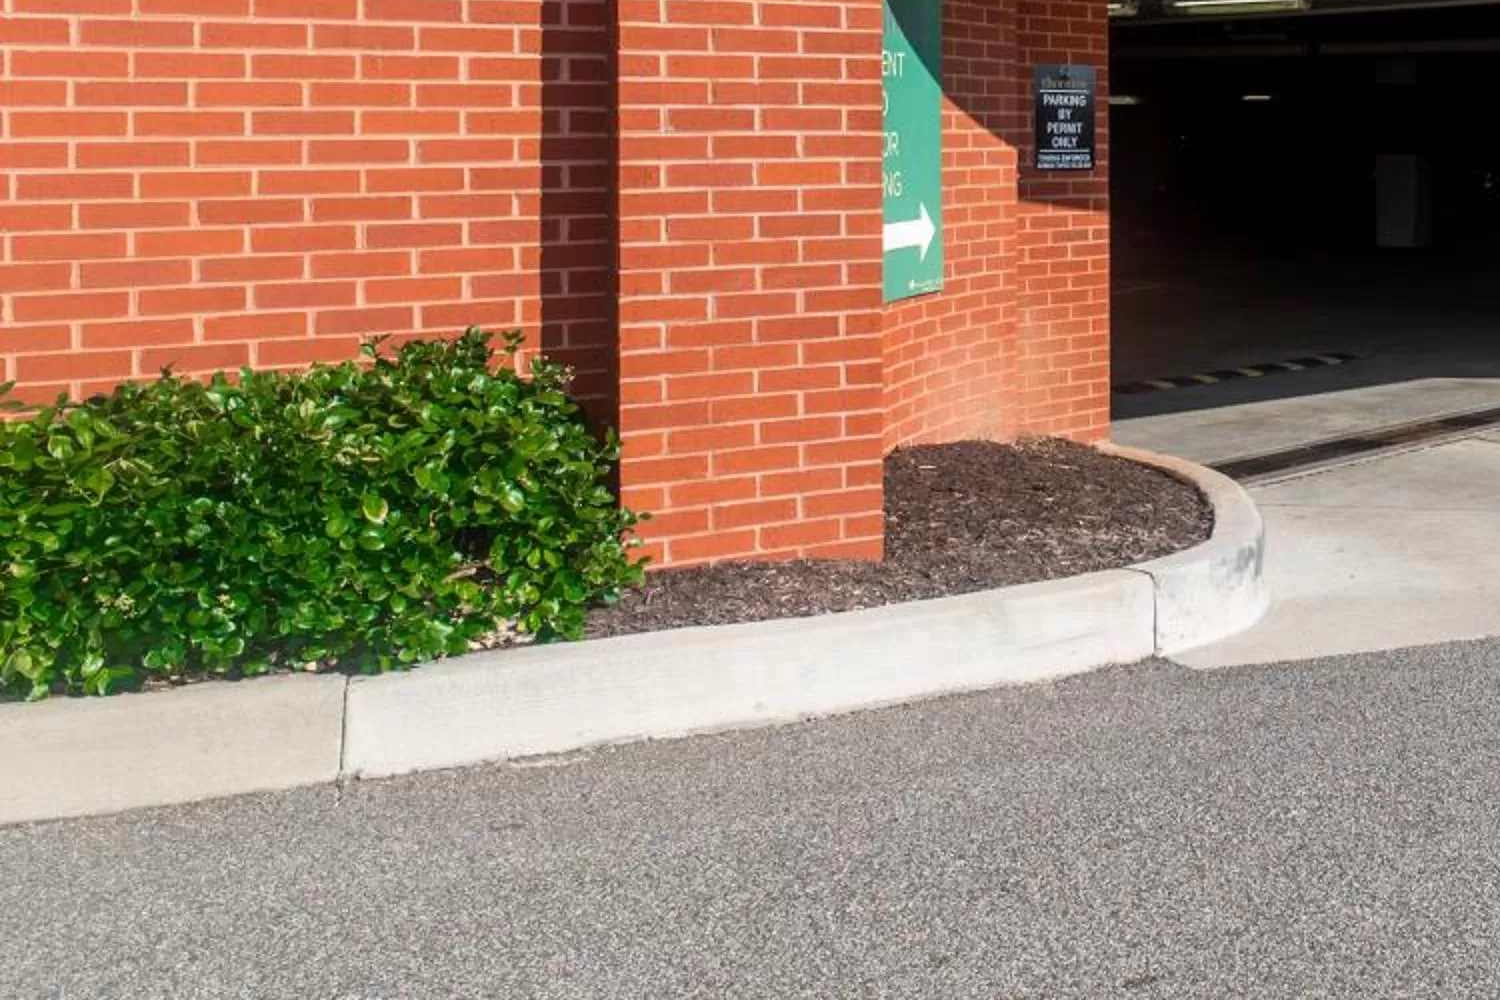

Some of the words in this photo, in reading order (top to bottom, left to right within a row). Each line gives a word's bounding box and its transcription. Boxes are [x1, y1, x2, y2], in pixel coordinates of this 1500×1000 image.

[1043, 93, 1087, 107] PARKING
[1057, 108, 1073, 120] BY
[1046, 121, 1083, 135] PERMIT
[1051, 136, 1079, 148] ONLY
